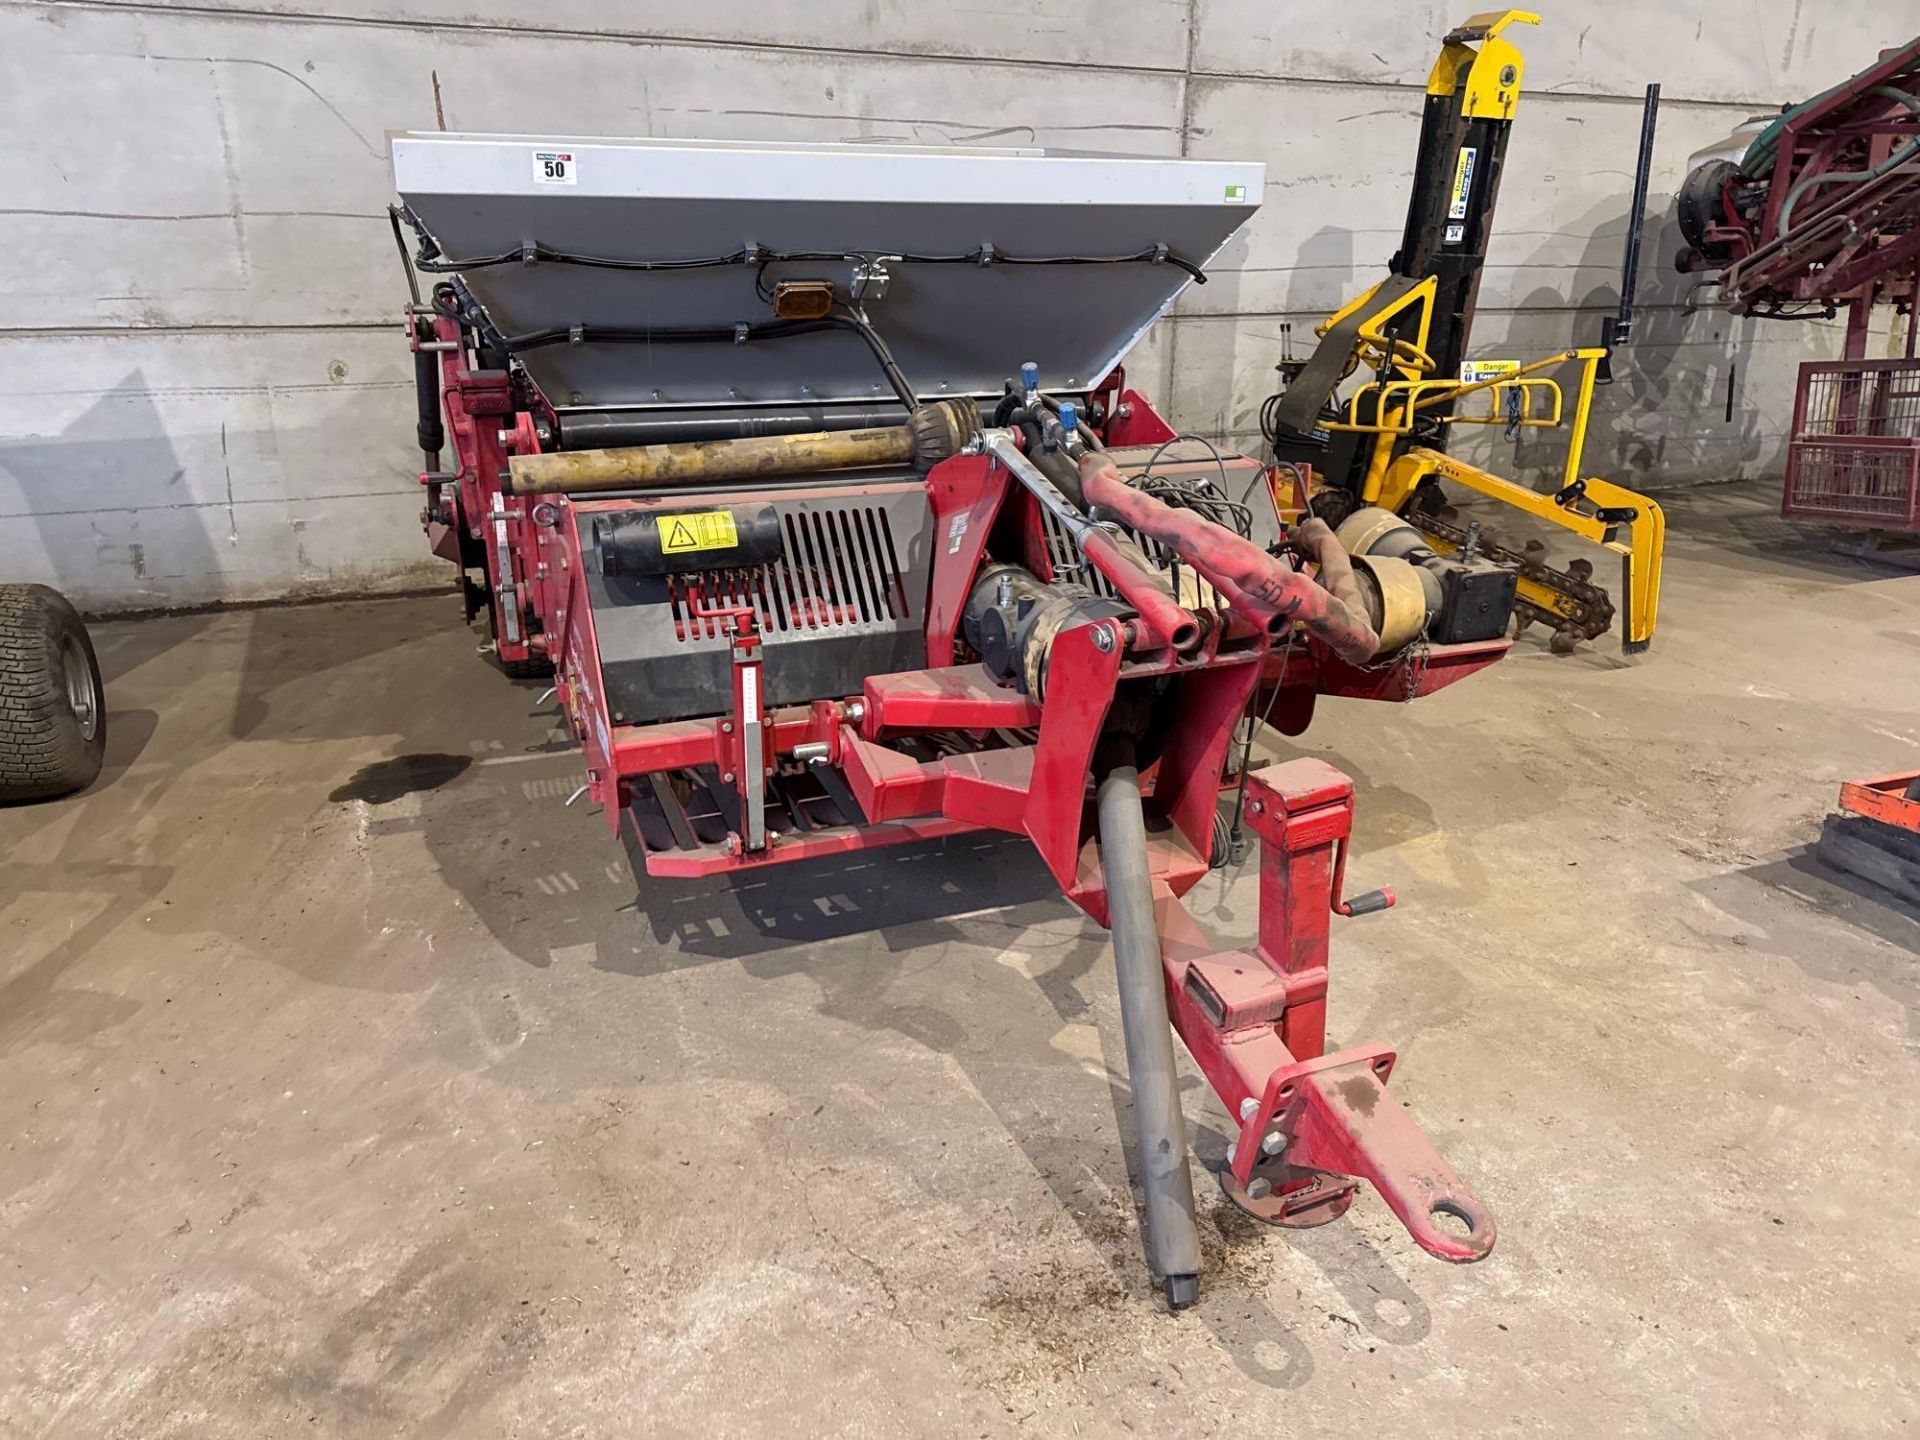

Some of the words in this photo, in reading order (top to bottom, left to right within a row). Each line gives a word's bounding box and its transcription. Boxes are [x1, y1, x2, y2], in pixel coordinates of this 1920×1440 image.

[544, 160, 565, 178] 50
[1455, 162, 1465, 191] Danger
[1483, 363, 1509, 372] Danger
